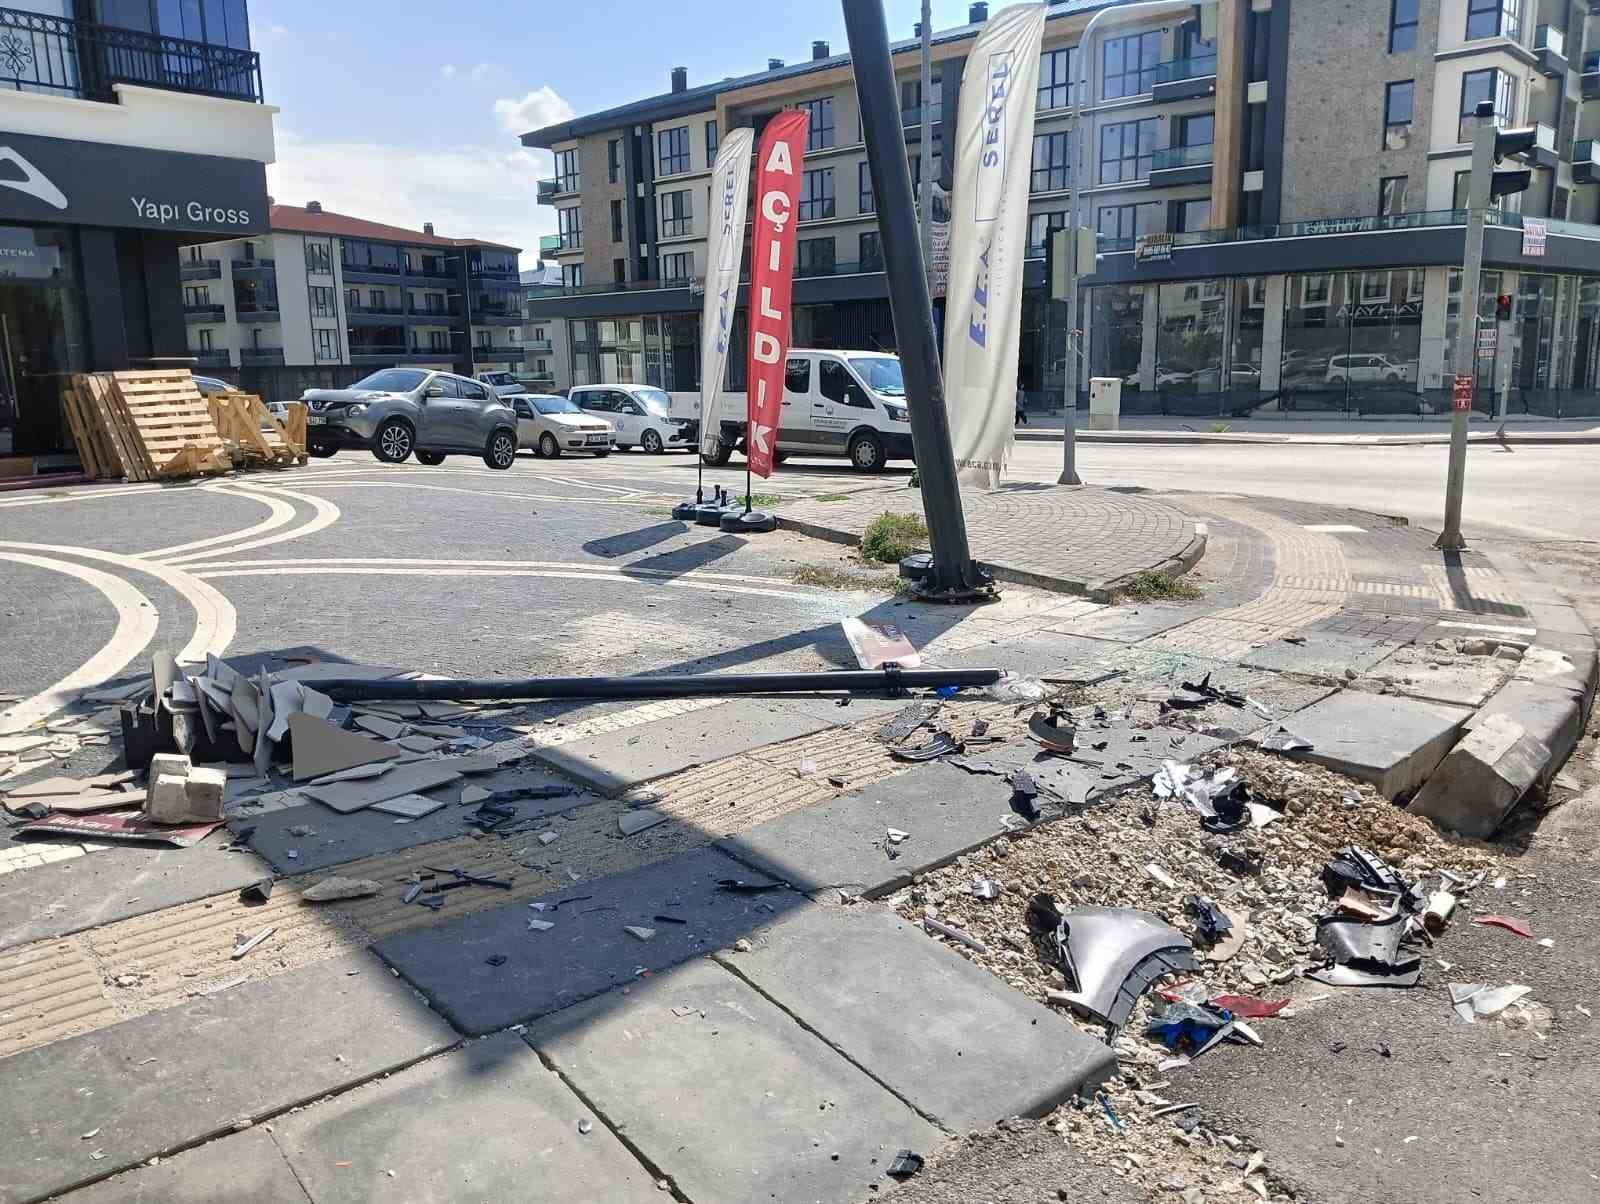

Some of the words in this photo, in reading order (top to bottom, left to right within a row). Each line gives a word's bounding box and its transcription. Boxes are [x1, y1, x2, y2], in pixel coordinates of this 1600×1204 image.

[983, 64, 1009, 168] SEREL
[131, 197, 180, 224] Yapı
[187, 202, 250, 225] Gross
[750, 140, 793, 456] AÇILDIK
